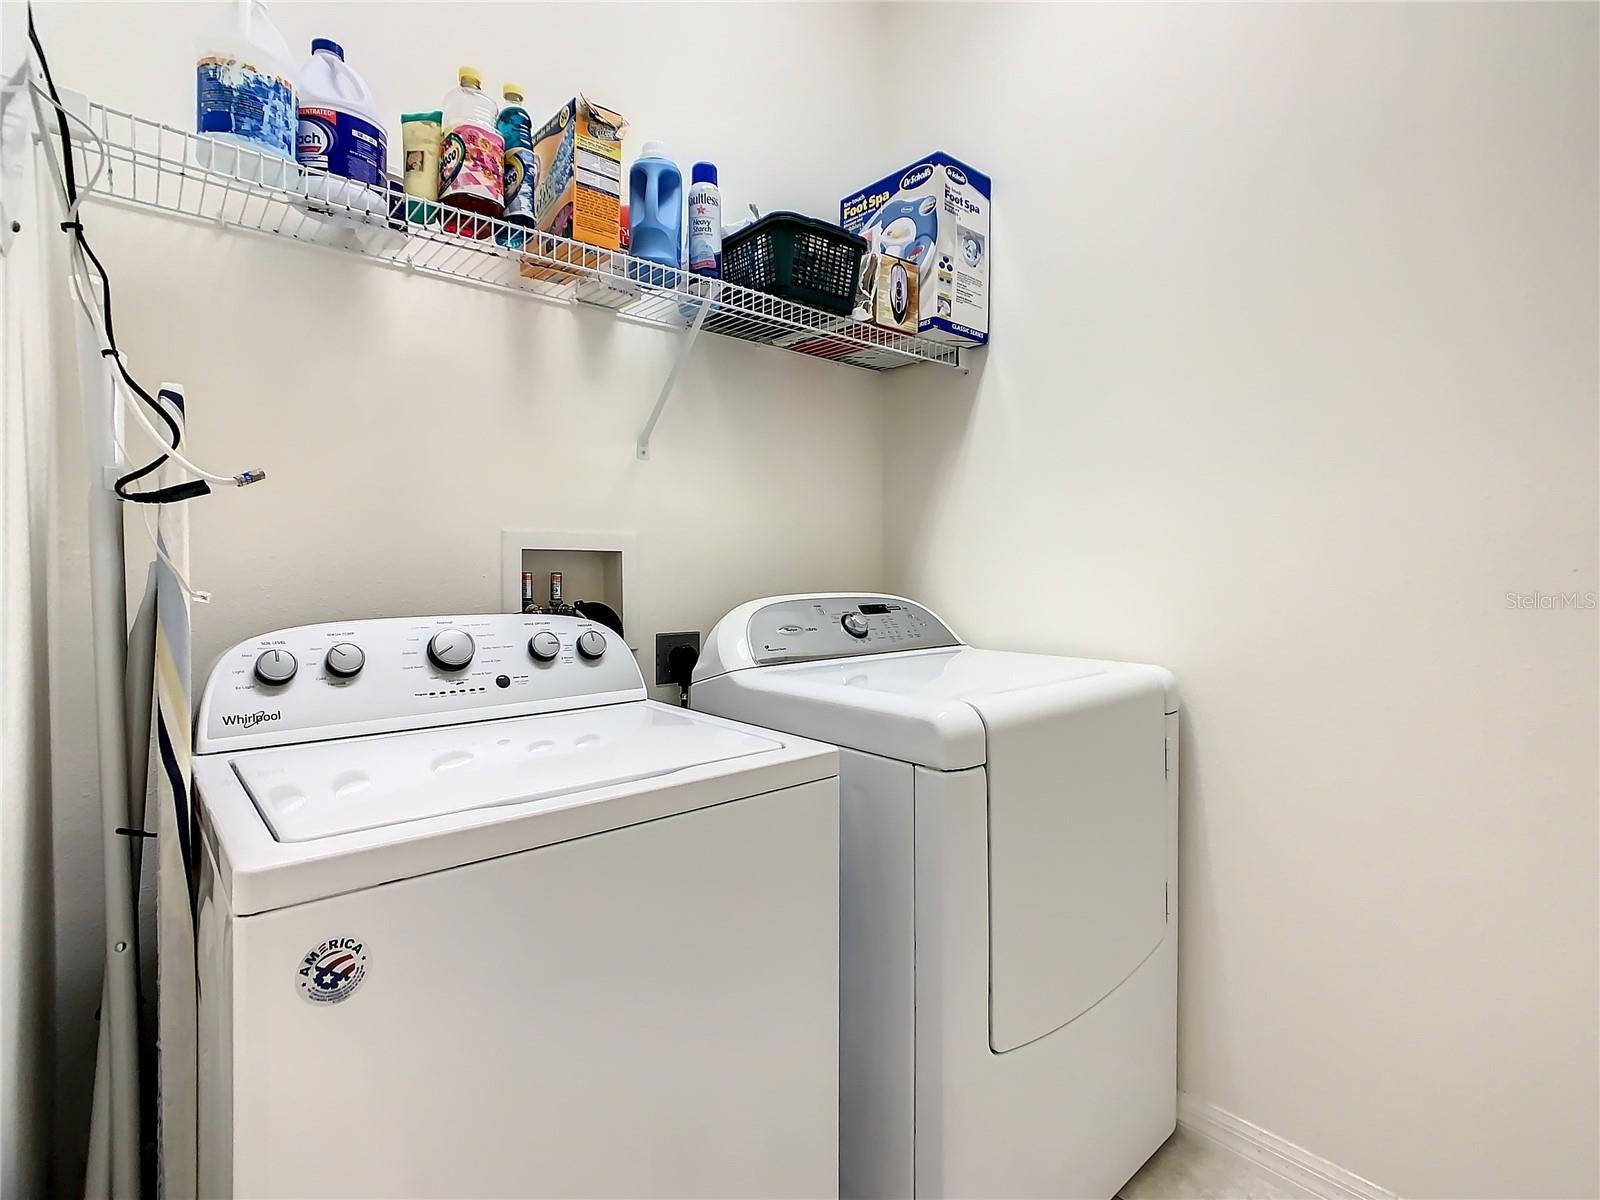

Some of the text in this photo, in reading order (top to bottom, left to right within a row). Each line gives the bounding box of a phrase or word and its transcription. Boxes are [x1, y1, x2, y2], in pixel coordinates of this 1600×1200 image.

[843, 200, 868, 220] Foot
[868, 191, 890, 208] Spa
[944, 189, 964, 206] Foot
[964, 199, 980, 214] Spa
[222, 710, 281, 729] Whirlpool
[299, 938, 363, 977] AMERICA
